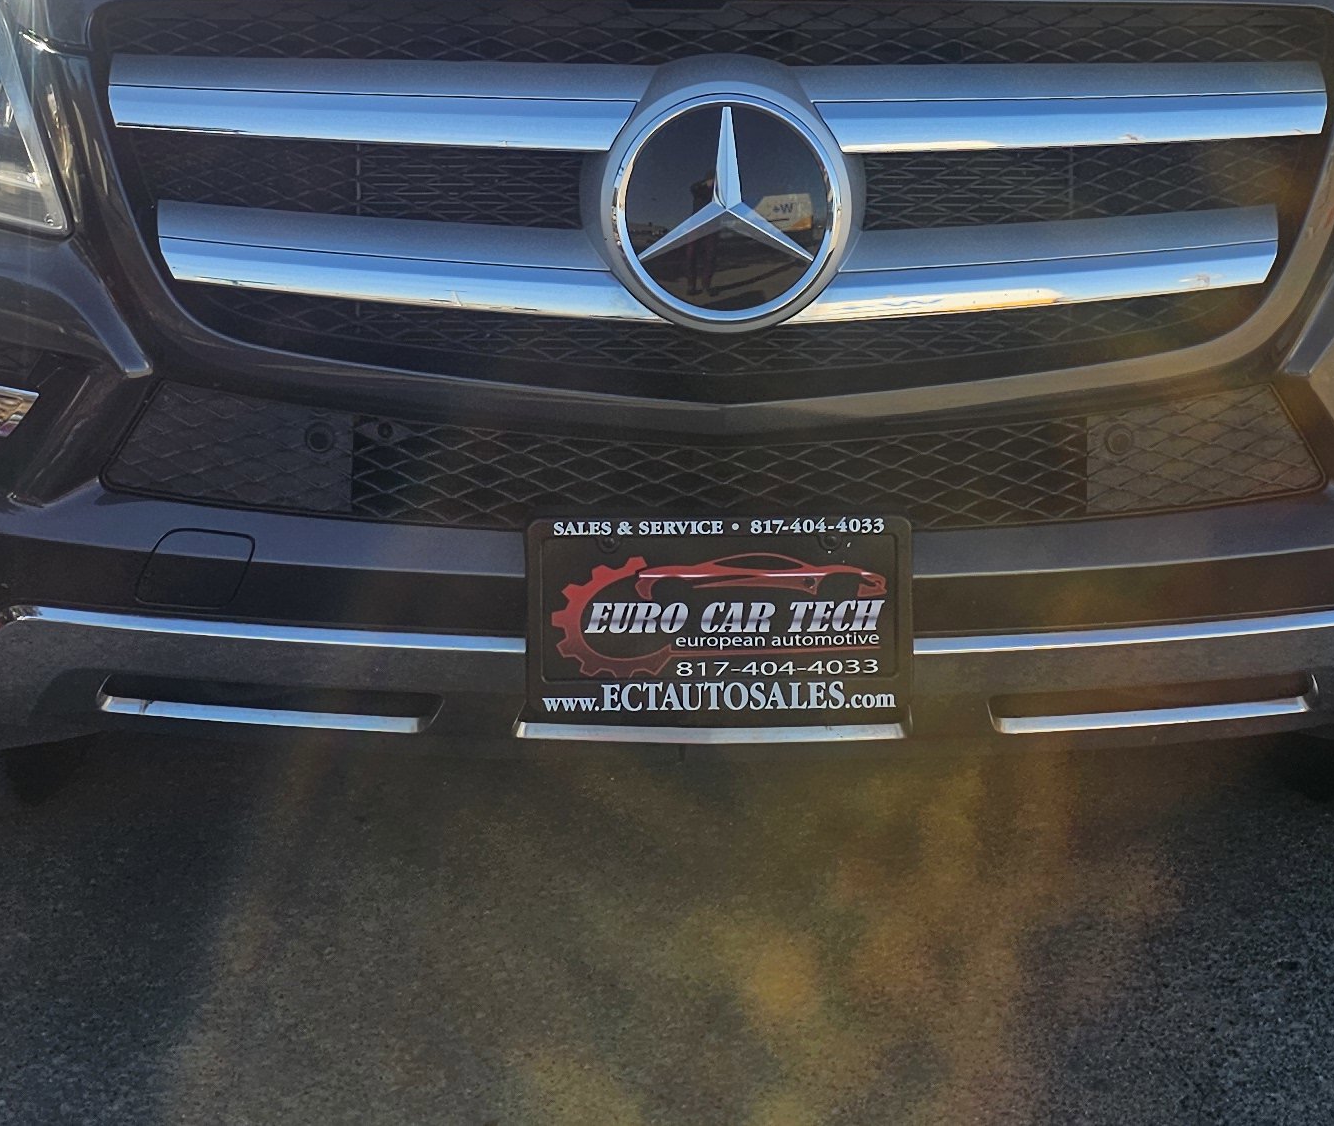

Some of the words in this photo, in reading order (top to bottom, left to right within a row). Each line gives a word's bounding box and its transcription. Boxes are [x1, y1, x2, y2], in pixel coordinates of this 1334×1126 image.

[552, 521, 613, 536] SALES
[617, 521, 634, 535] &
[638, 520, 724, 535] SERVICE
[749, 517, 886, 535] 817-404-4033
[584, 601, 689, 634] EURO
[699, 601, 776, 633] CAR
[787, 599, 886, 632] TECH
[675, 633, 766, 650] european
[771, 631, 881, 648] automotive
[675, 659, 880, 677] 817-404-4033
[542, 680, 897, 712] www.ECTAUTOSALES.com
